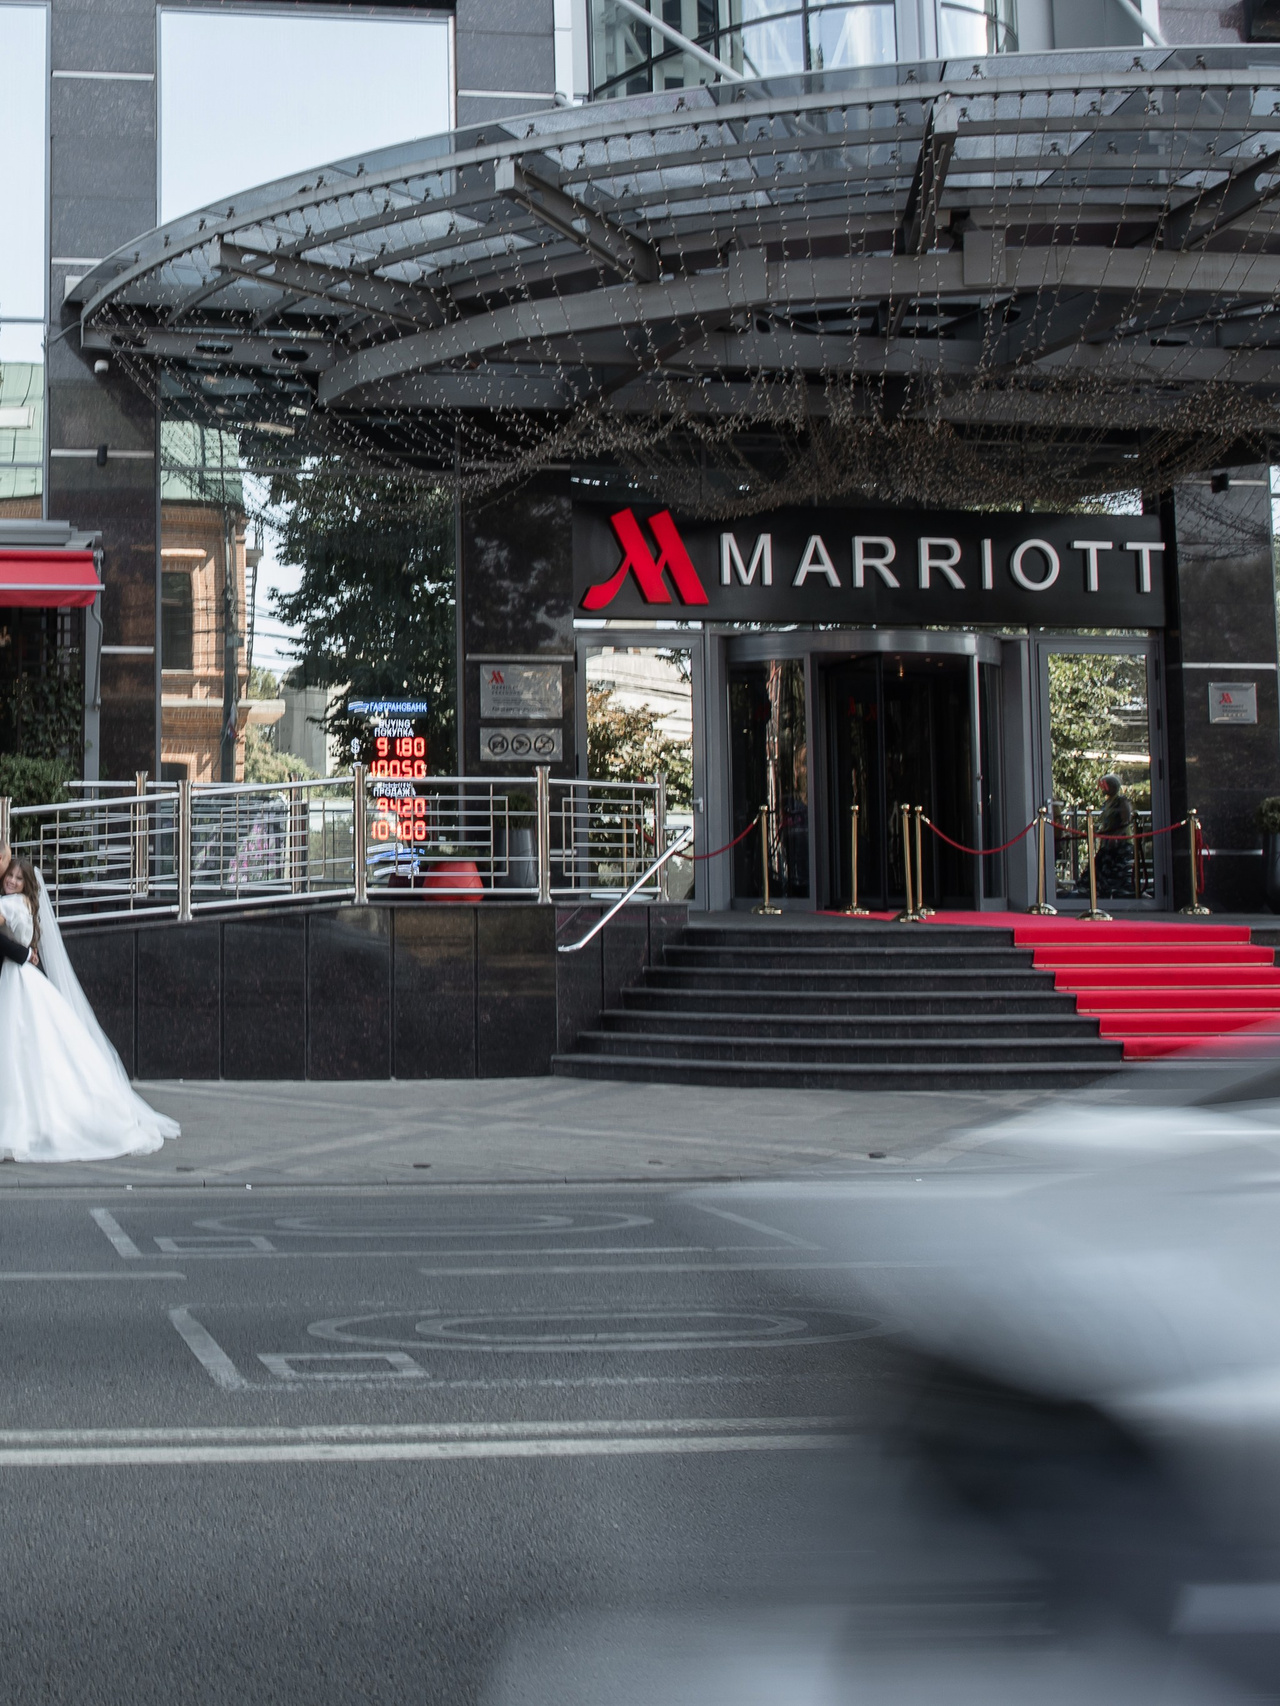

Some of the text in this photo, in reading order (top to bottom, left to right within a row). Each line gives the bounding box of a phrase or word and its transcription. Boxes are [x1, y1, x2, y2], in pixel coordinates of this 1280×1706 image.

[720, 533, 1165, 593] MARRIOTT
[369, 701, 428, 713] ГАЗТРАНСБАНК
[378, 718, 411, 728] BUYING
[374, 727, 415, 738] ПОКУПКА
